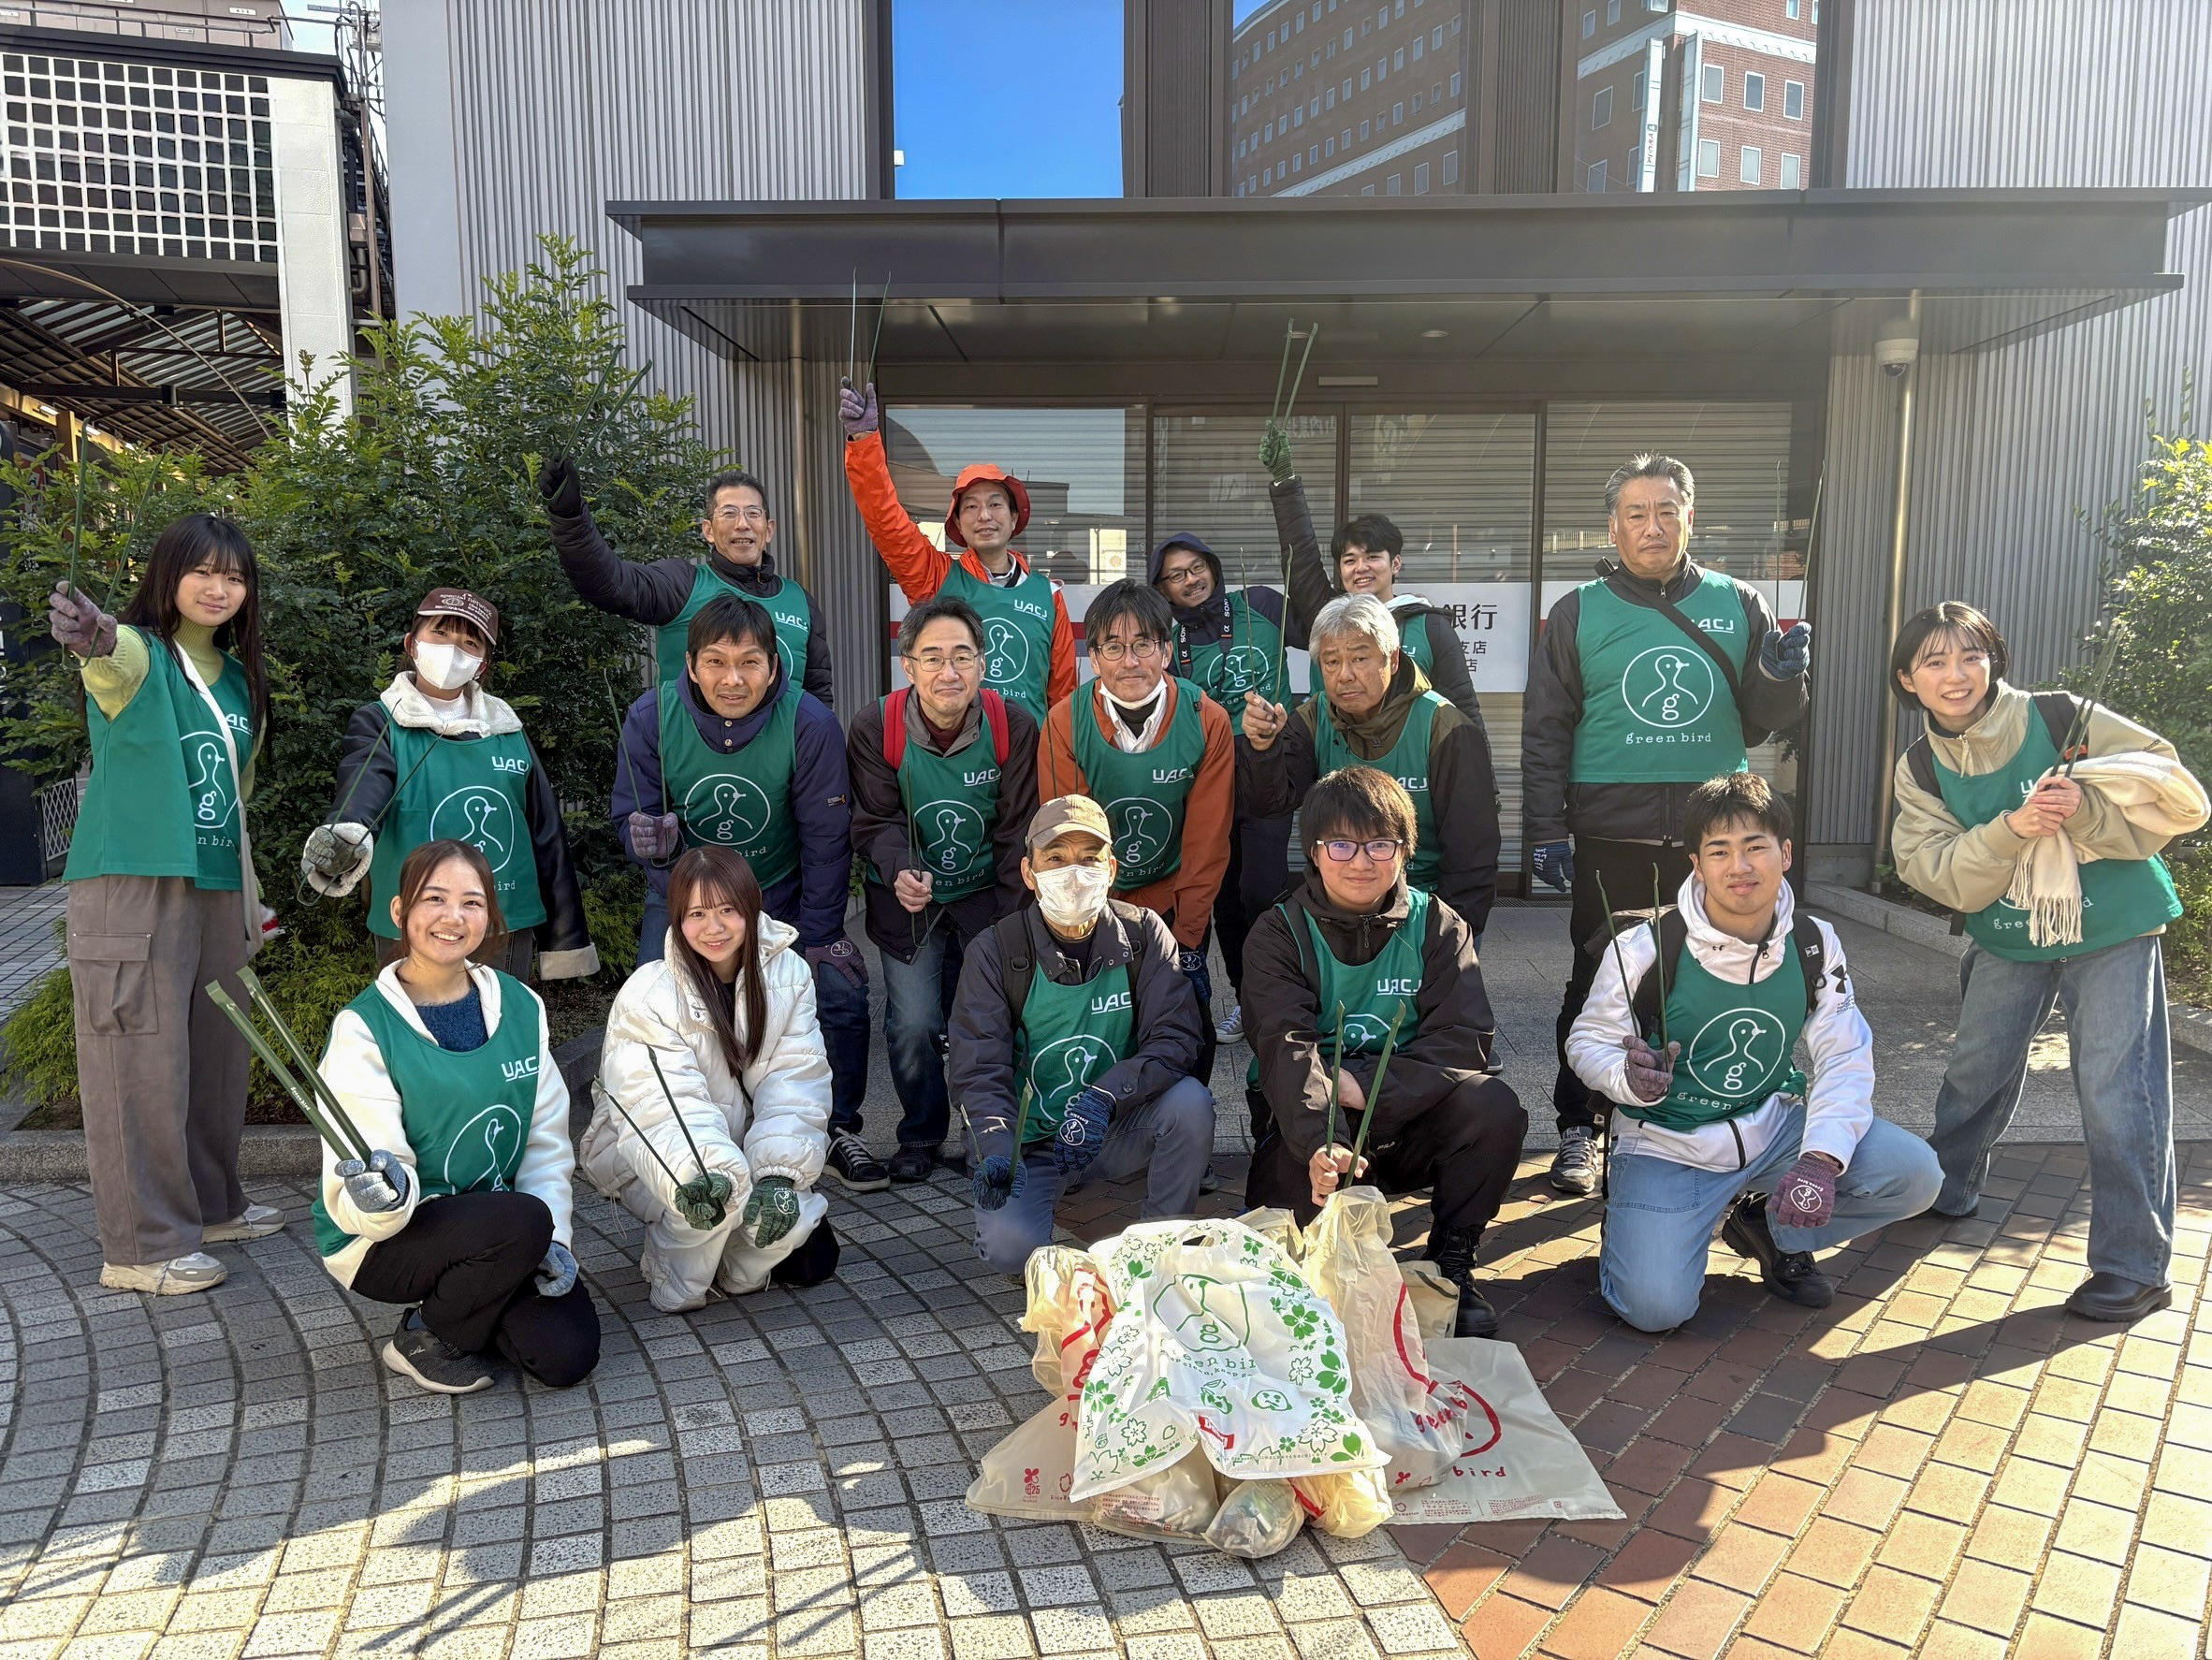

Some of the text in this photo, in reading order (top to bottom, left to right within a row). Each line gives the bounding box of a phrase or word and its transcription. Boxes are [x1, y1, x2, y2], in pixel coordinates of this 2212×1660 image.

[1013, 599, 1048, 620] UACJ
[1691, 619, 1734, 633] ACJ
[1003, 688, 1026, 698] bird
[1625, 732, 1711, 744] green bird
[1397, 777, 1429, 792] ACJ
[957, 869, 984, 884] bird
[1375, 978, 1422, 996] UACJ
[1091, 992, 1132, 1014] UAC
[501, 1056, 540, 1082] UAC
[1677, 1092, 1732, 1110] green
[1452, 1465, 1506, 1478] bird
